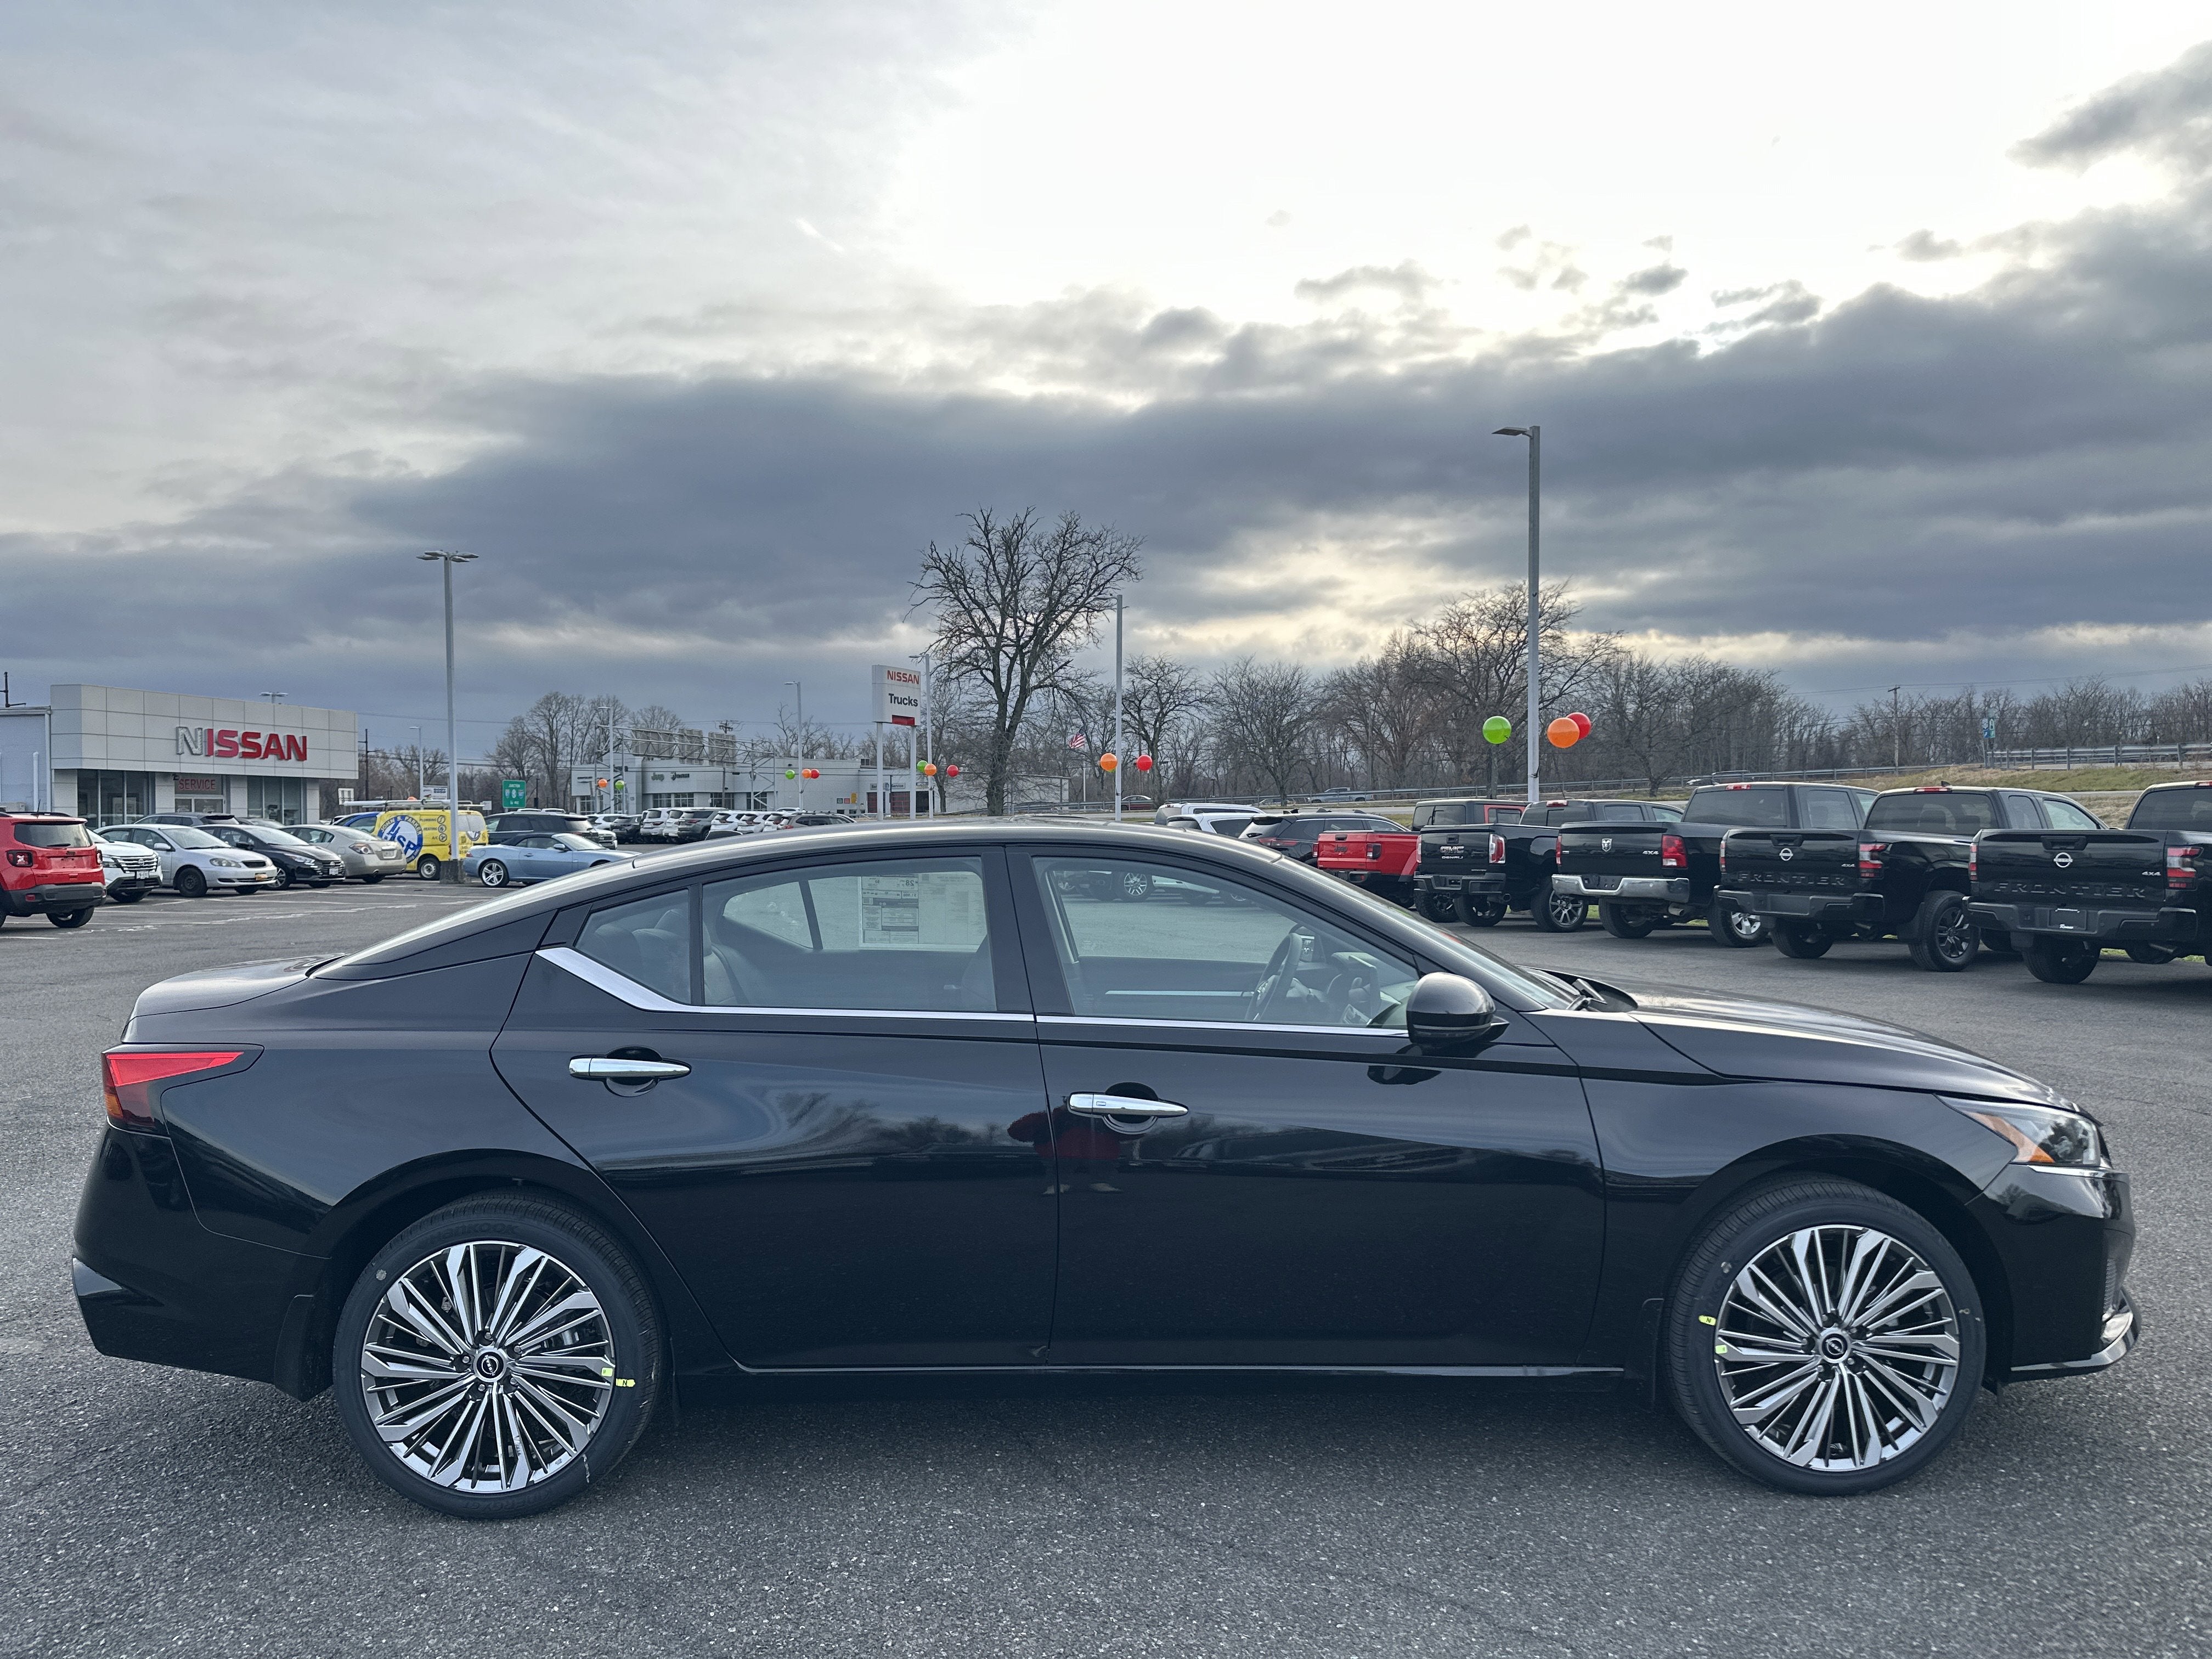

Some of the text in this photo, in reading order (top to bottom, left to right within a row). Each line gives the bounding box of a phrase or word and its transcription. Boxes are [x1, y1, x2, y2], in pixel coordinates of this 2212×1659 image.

[887, 670, 920, 685] NISSAN
[888, 693, 918, 707] Trucks
[176, 726, 307, 761] NISSAN
[178, 778, 216, 791] SERVICE
[1440, 845, 1465, 854] GMC
[1737, 872, 1845, 886] FRONTIER
[1994, 883, 2146, 898] FRONTIER
